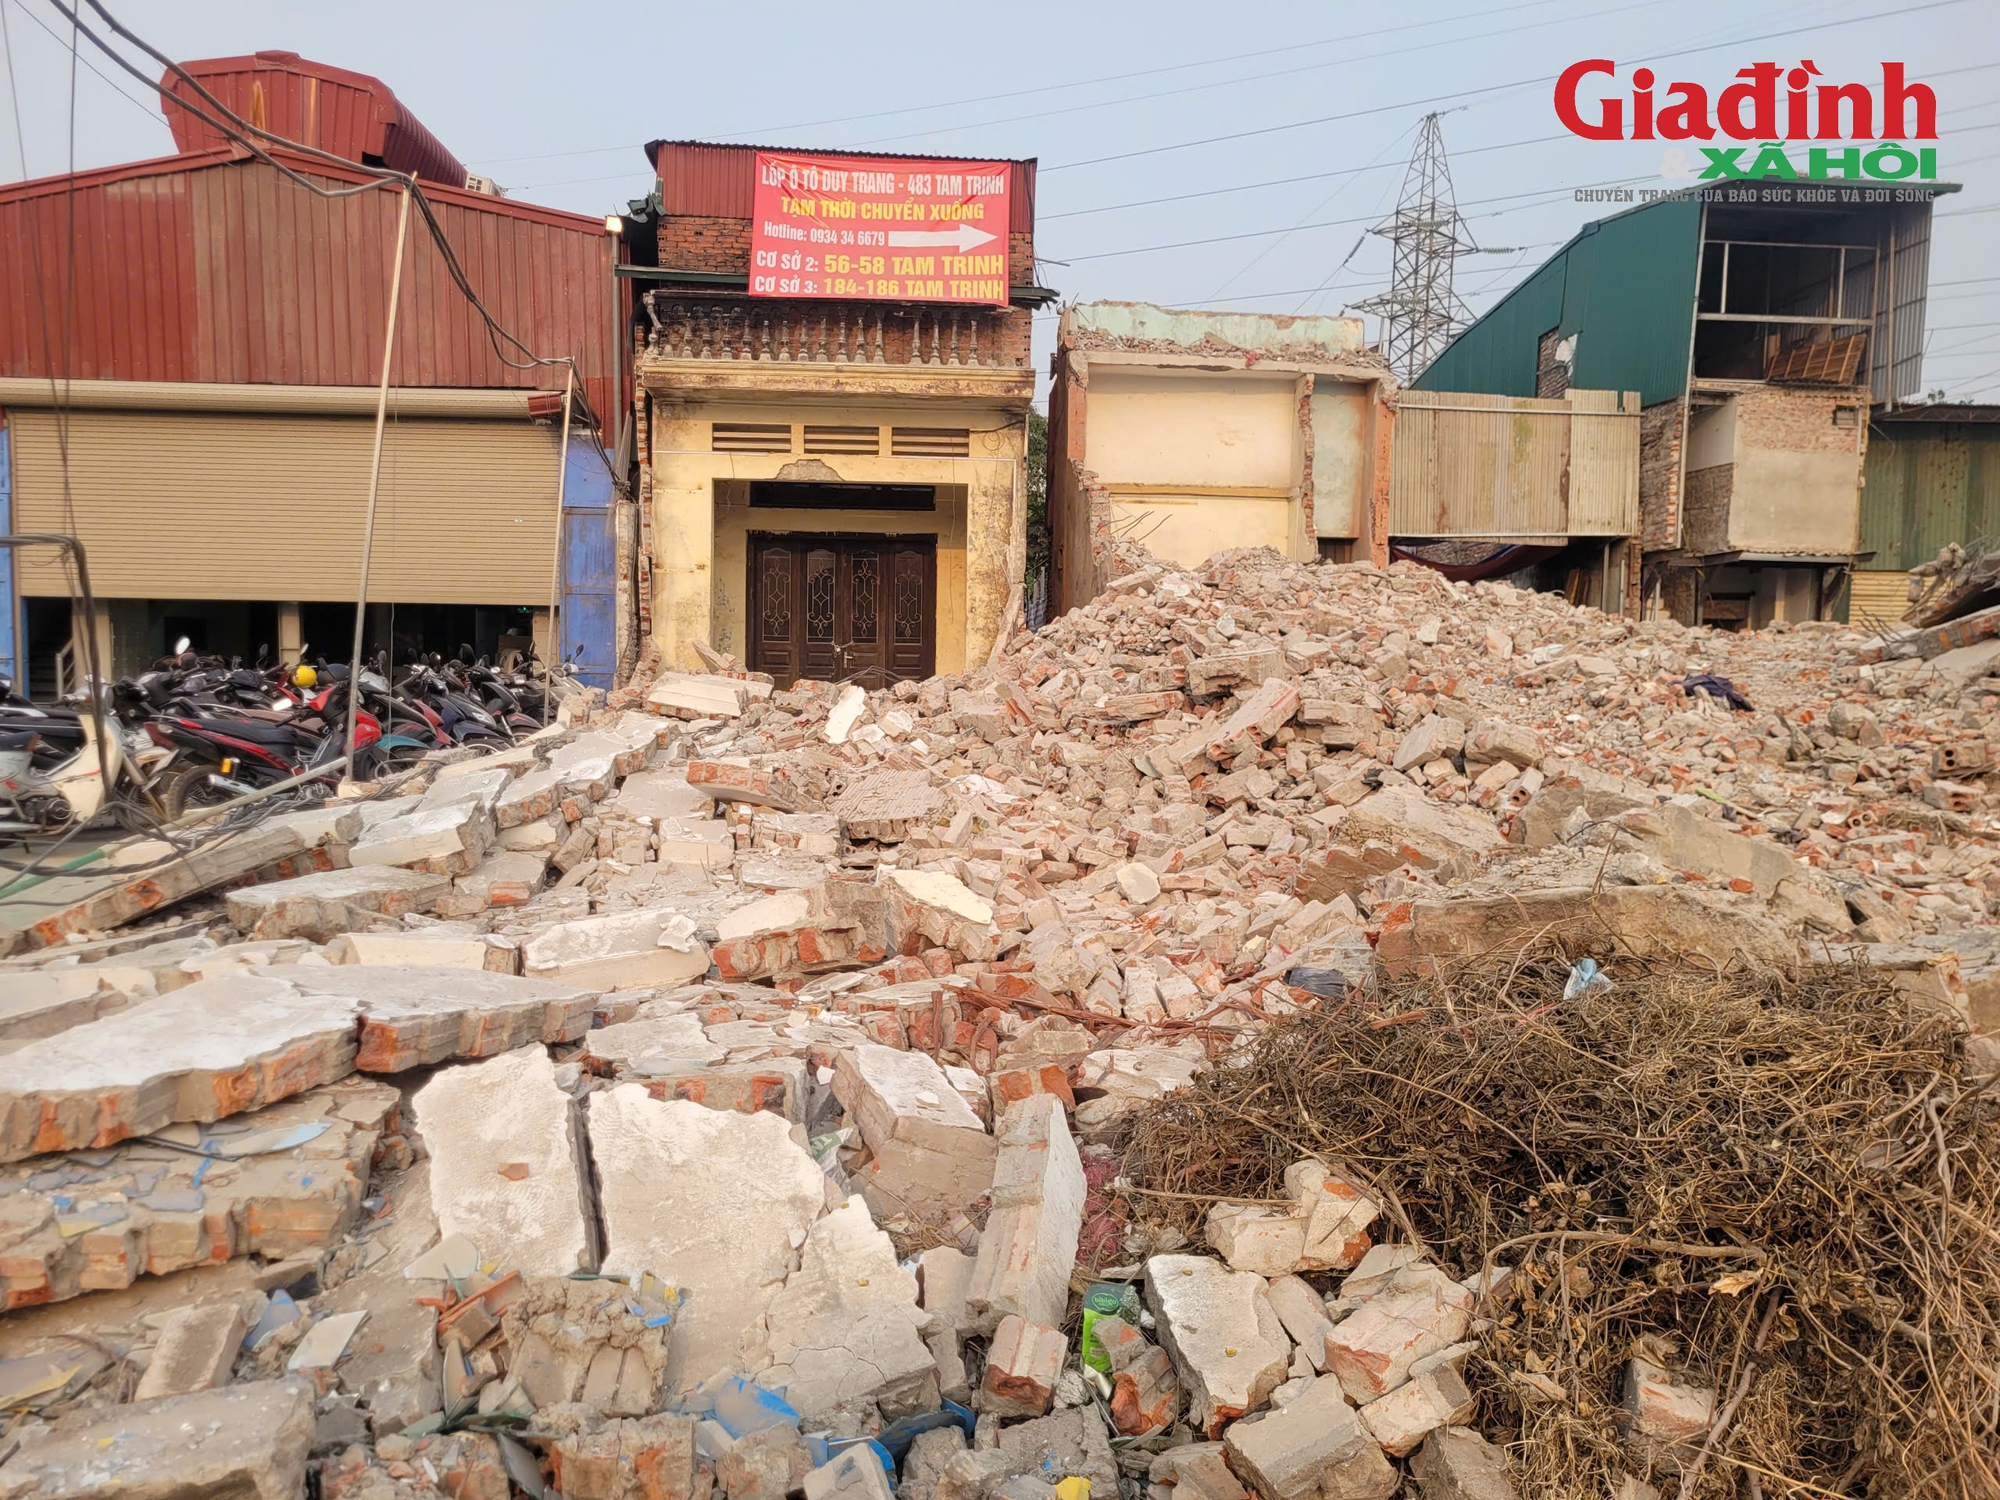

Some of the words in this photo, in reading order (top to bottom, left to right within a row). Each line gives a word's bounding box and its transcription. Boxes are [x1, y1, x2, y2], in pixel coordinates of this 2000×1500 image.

[761, 161, 786, 188] LỐP
[789, 165, 799, 190] Ô
[802, 165, 819, 190] TÔ
[822, 170, 848, 192] DUY
[852, 171, 895, 194] TRANG
[907, 174, 932, 196] 483
[935, 175, 962, 196] TAM
[966, 175, 1004, 196] TRINH
[781, 196, 815, 218] TẠM
[820, 197, 856, 219] THỜI
[860, 197, 925, 220] CHUYỂN
[929, 198, 984, 220] XUỐNG
[764, 221, 807, 242] Hotline:
[810, 228, 837, 244] 0934
[840, 230, 855, 246] 34
[857, 231, 885, 246] 6679
[756, 250, 777, 268] CƠ
[780, 249, 801, 271] SỞ
[805, 256, 819, 272] 2:
[824, 254, 885, 275] 56-58
[891, 256, 935, 275] TAM
[941, 254, 1004, 276] TRINH
[755, 275, 776, 292] CƠ
[779, 274, 801, 293] SỞ
[804, 280, 818, 294] 3:
[823, 277, 899, 296] 184-186
[905, 279, 944, 298] TAM
[949, 279, 1004, 301] TRINH
[1094, 1297, 1117, 1305] bibigo
